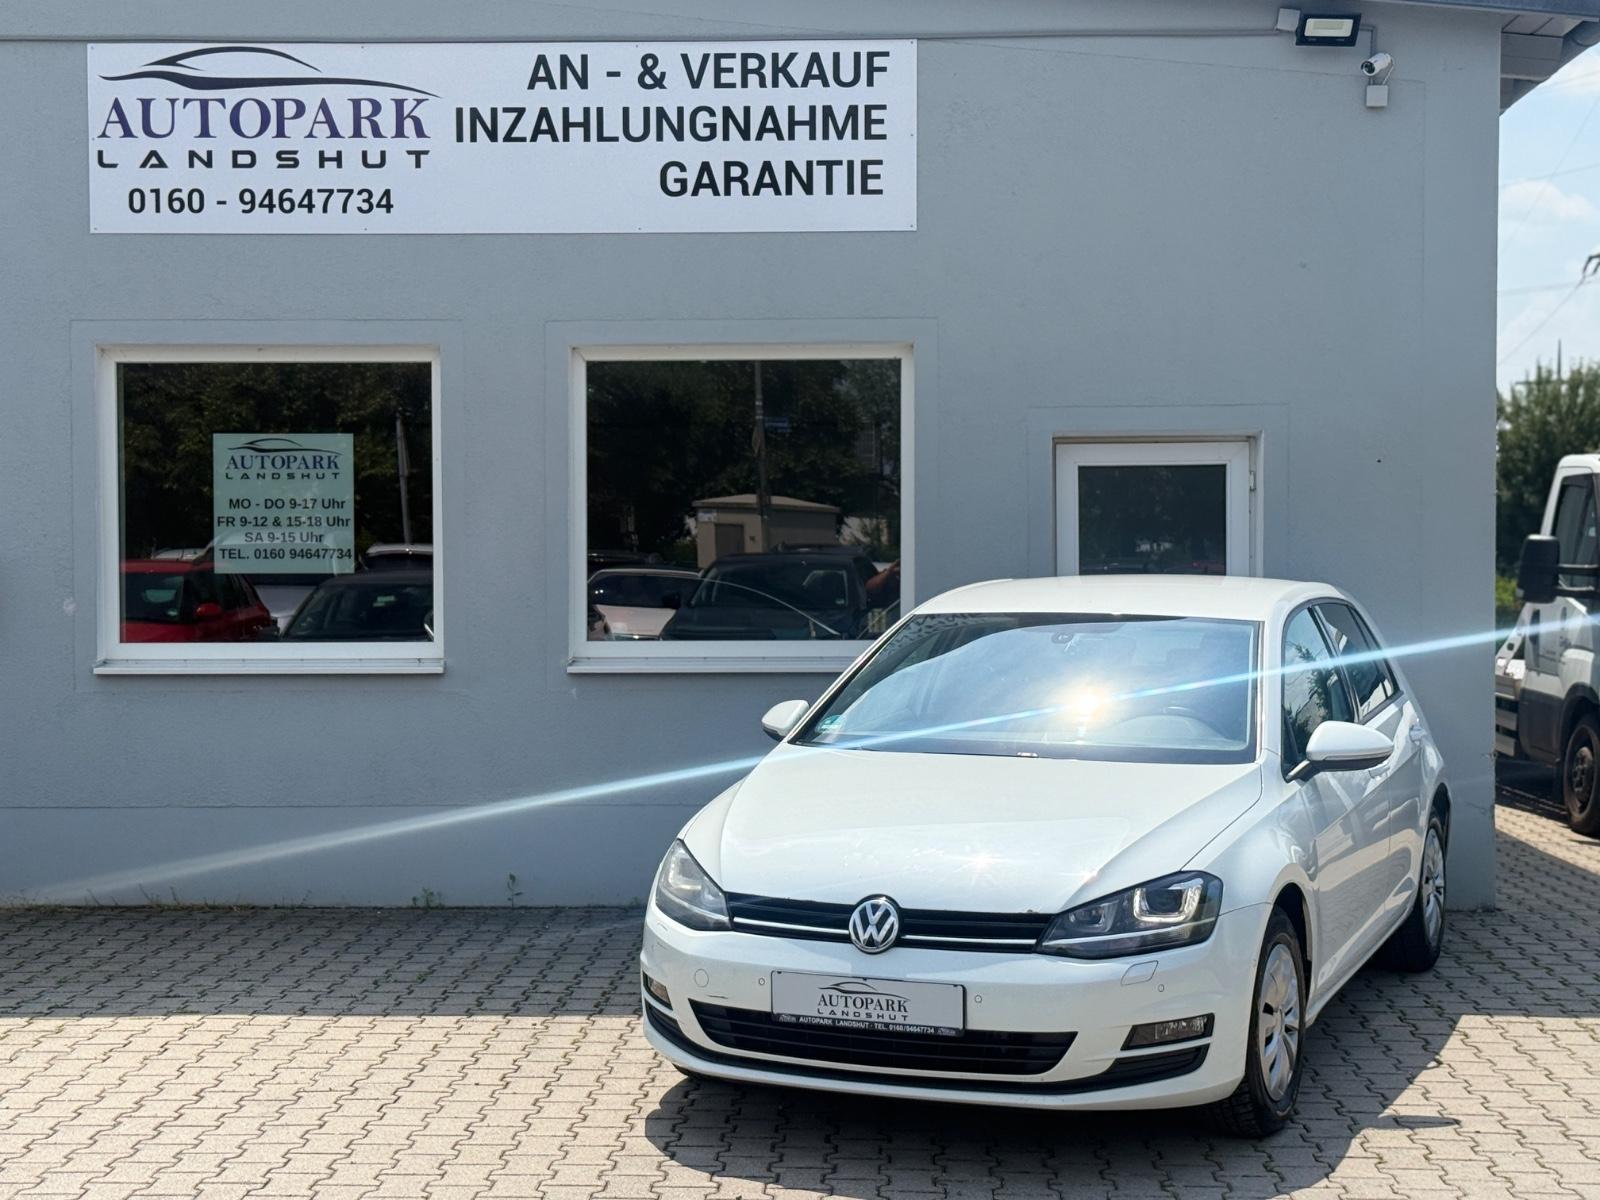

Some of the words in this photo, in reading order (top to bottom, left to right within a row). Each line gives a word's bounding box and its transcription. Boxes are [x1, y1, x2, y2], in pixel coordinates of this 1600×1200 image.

[527, 54, 589, 90] AN
[637, 53, 667, 90] &
[680, 51, 890, 89] VERKAUF
[97, 97, 432, 139] AUTOPARK
[455, 104, 888, 143] INZAHLUNGNAHME
[97, 149, 430, 169] LANDSHUT
[659, 159, 884, 197] GARANTIE
[128, 188, 205, 214] 0160
[239, 188, 394, 214] 94647734
[226, 455, 340, 470] AUTOPARK
[225, 472, 340, 480] LANDSHUT
[228, 498, 251, 509] MO
[264, 498, 285, 509] DO
[289, 498, 317, 509] 9-17
[321, 498, 346, 509] Uhr
[217, 516, 236, 527] FR
[240, 516, 268, 527] 9-12
[272, 516, 282, 527] &
[286, 516, 322, 527] 15-18
[326, 516, 351, 527] Uhr
[244, 532, 264, 543] SA
[267, 532, 296, 543] 9-15
[300, 532, 324, 543] Uhr
[219, 548, 250, 560] TEL.
[254, 548, 285, 560] 0160
[289, 548, 352, 560] 94647734
[849, 899, 899, 952] VW
[817, 994, 908, 1013] AUTOPARK
[799, 1016, 833, 1025] AUTOPARK
[835, 1020, 869, 1029] LANDSHUT
[817, 1008, 909, 1021] LANDSHUT
